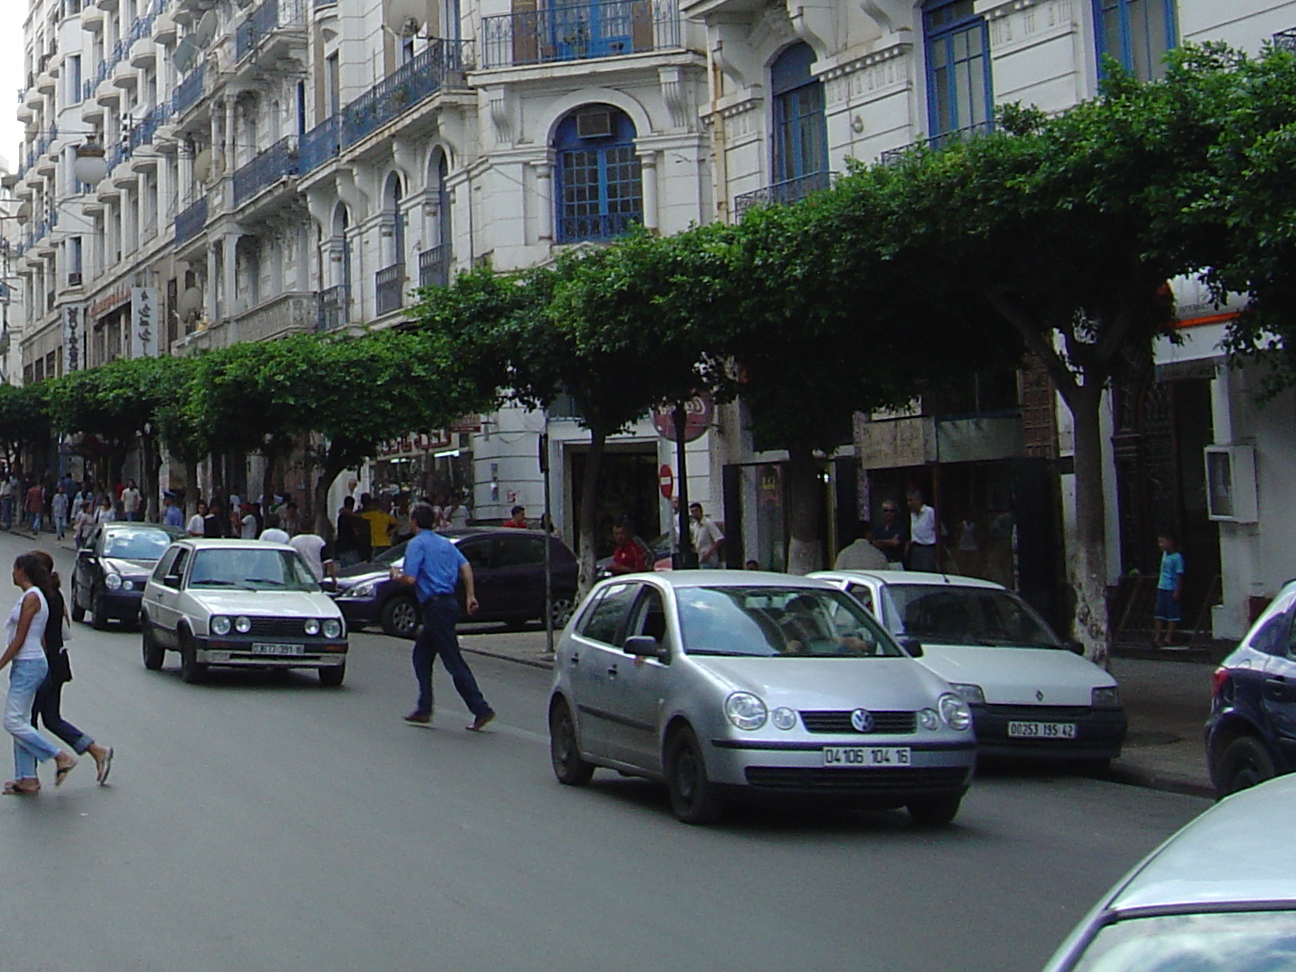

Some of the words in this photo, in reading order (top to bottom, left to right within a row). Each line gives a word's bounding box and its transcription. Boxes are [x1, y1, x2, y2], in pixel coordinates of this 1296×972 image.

[1010, 722, 1039, 736] 00253
[1043, 723, 1058, 736] 195
[1062, 724, 1073, 737] 42
[825, 748, 864, 764] 04106
[871, 748, 890, 764] 104
[896, 748, 908, 764] 16
